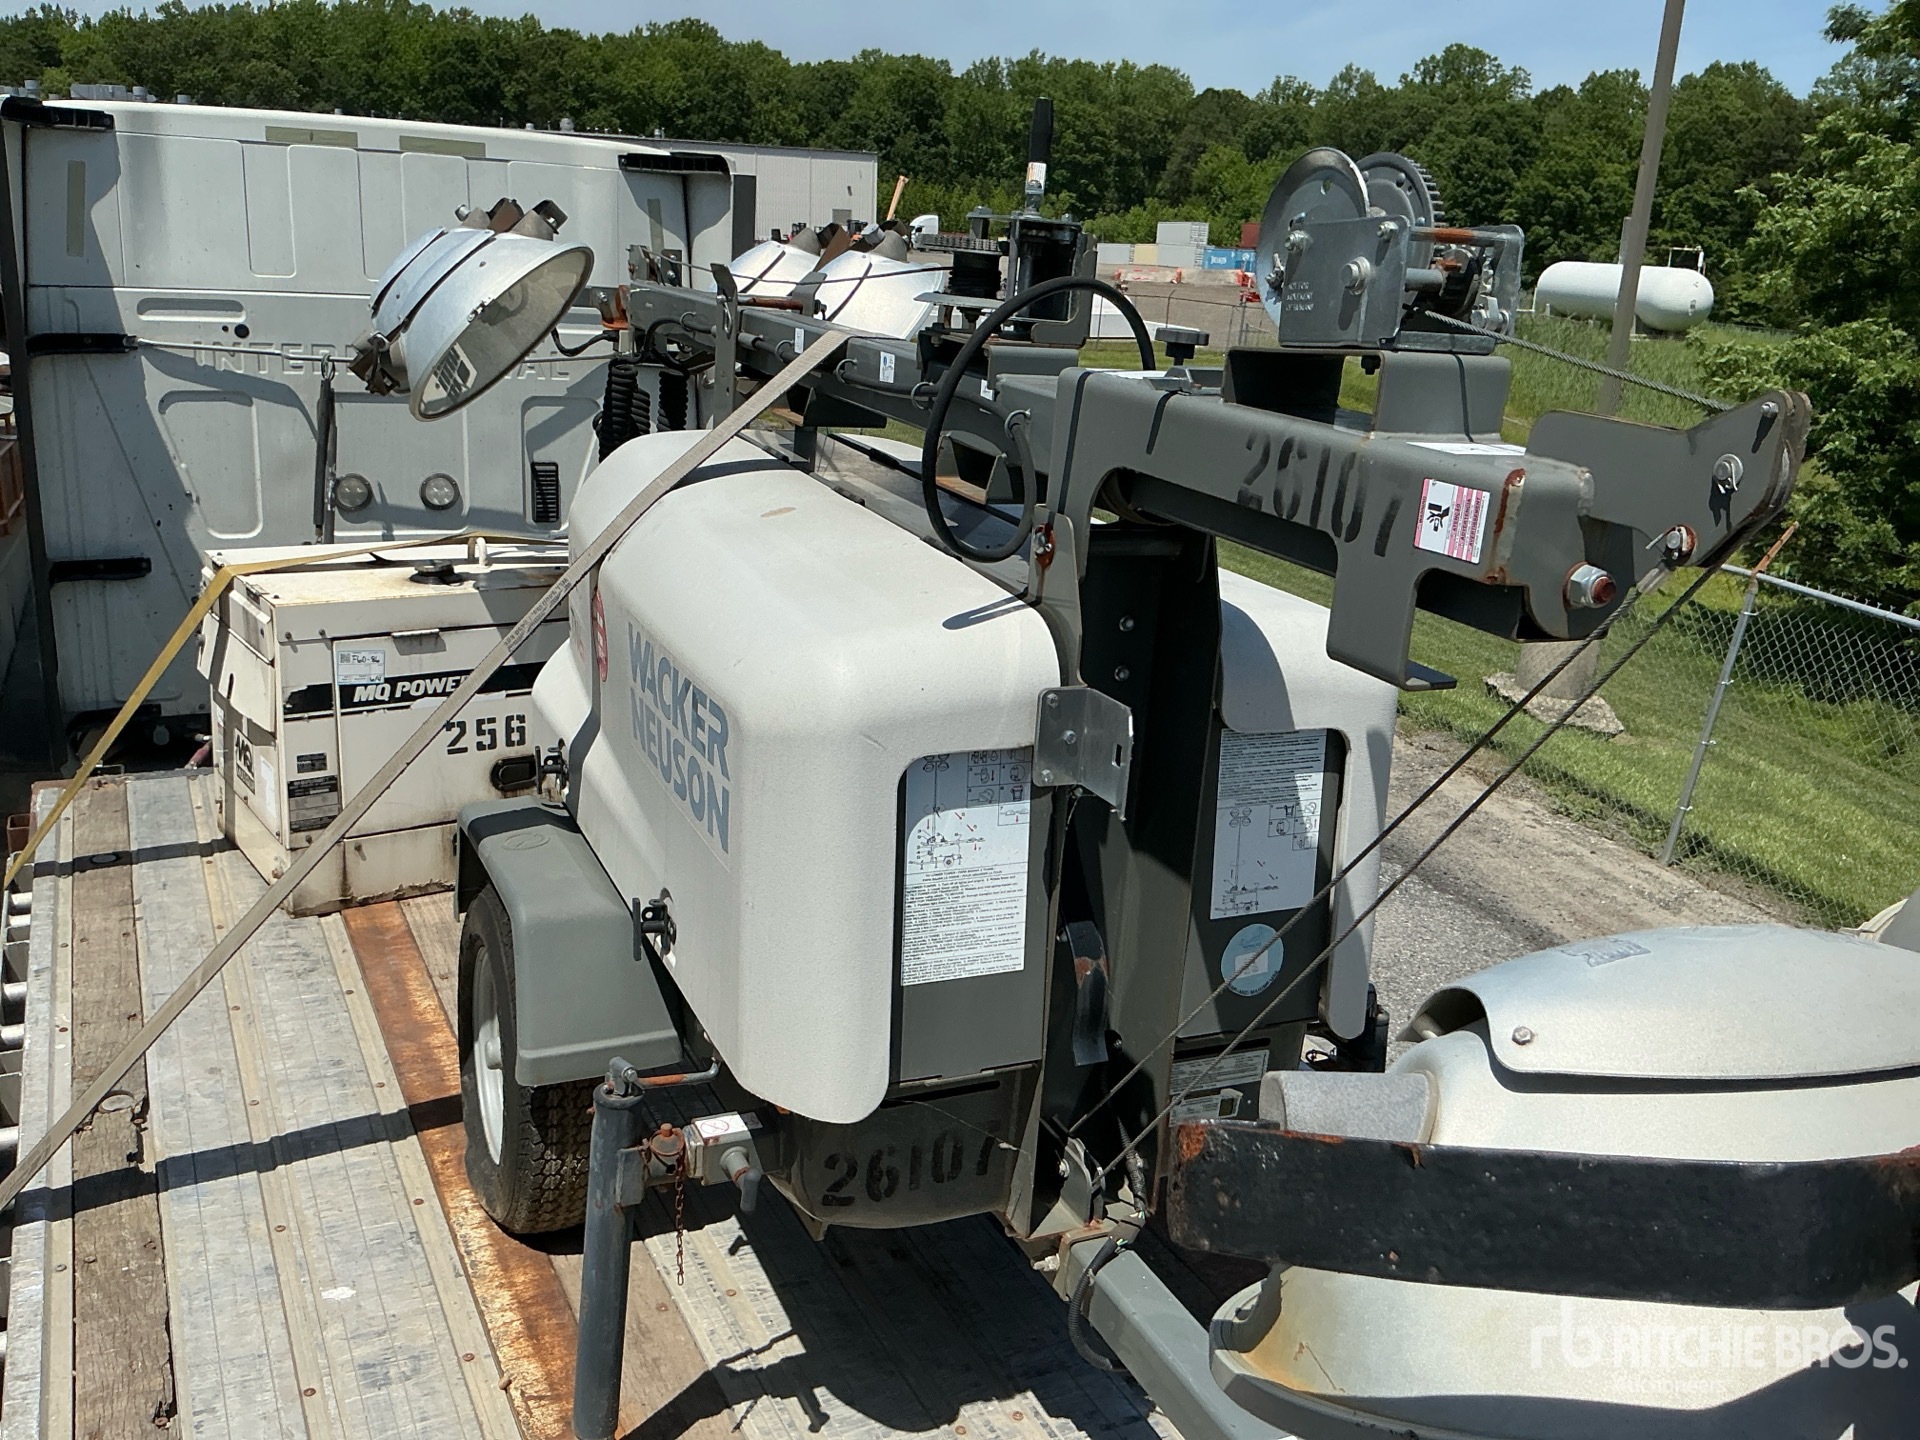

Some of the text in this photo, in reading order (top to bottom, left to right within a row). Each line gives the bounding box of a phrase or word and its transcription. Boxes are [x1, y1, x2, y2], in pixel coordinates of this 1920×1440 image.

[353, 684, 391, 703] MQ
[445, 714, 526, 755] 256
[628, 621, 730, 782] WACKER
[630, 686, 729, 855] NEUSON
[821, 1119, 1001, 1207] 26107
